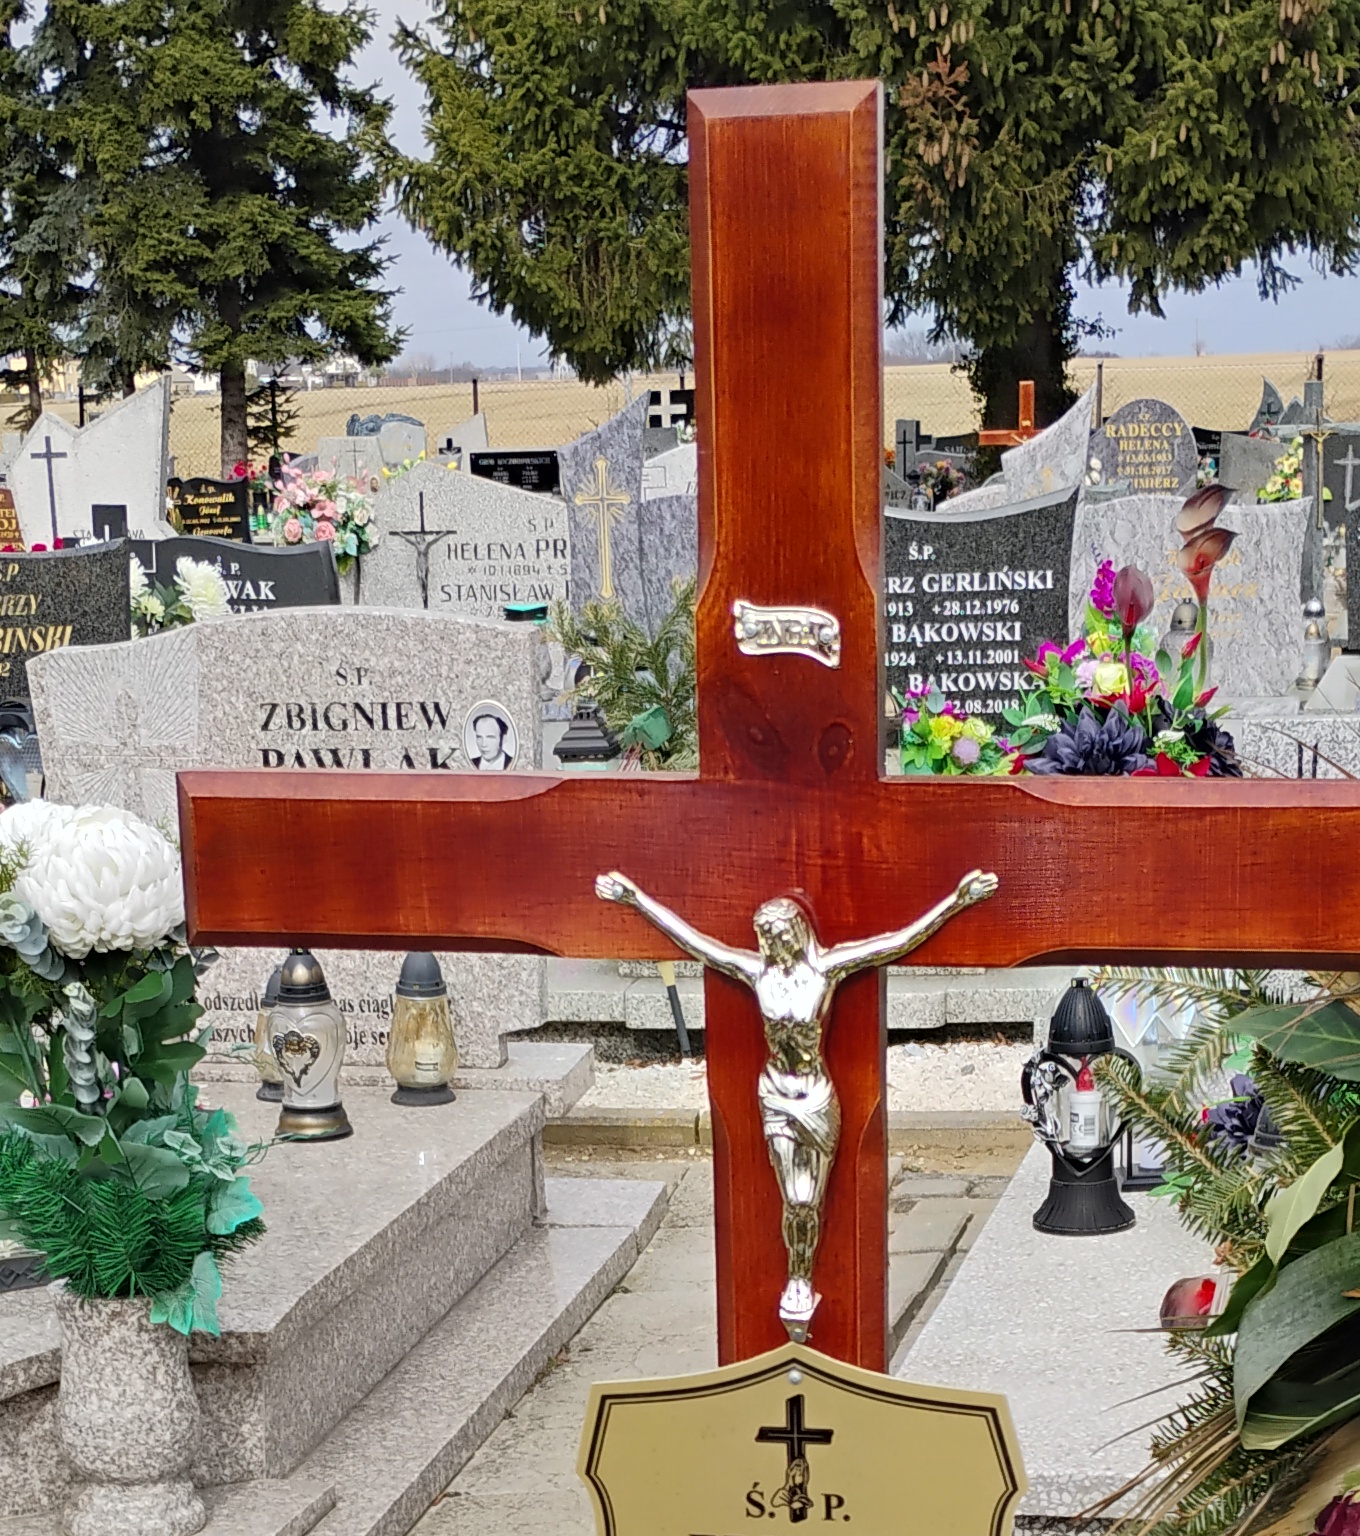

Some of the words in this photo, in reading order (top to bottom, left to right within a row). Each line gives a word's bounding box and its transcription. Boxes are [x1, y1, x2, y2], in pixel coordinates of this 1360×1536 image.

[1105, 422, 1184, 438] RADECCY
[1119, 439, 1169, 450] HELENA
[447, 542, 526, 561] HELENA
[222, 580, 277, 600] WAK
[922, 565, 1054, 594] GERLIŃSKI
[441, 580, 554, 602] STANISŁAW
[892, 621, 1022, 647] BĄKOWSKI
[908, 671, 1046, 692] BKOWSKA
[259, 701, 453, 732] ZBIGNIEW
[745, 1482, 776, 1520] Ś.
[822, 1493, 852, 1523] P.
